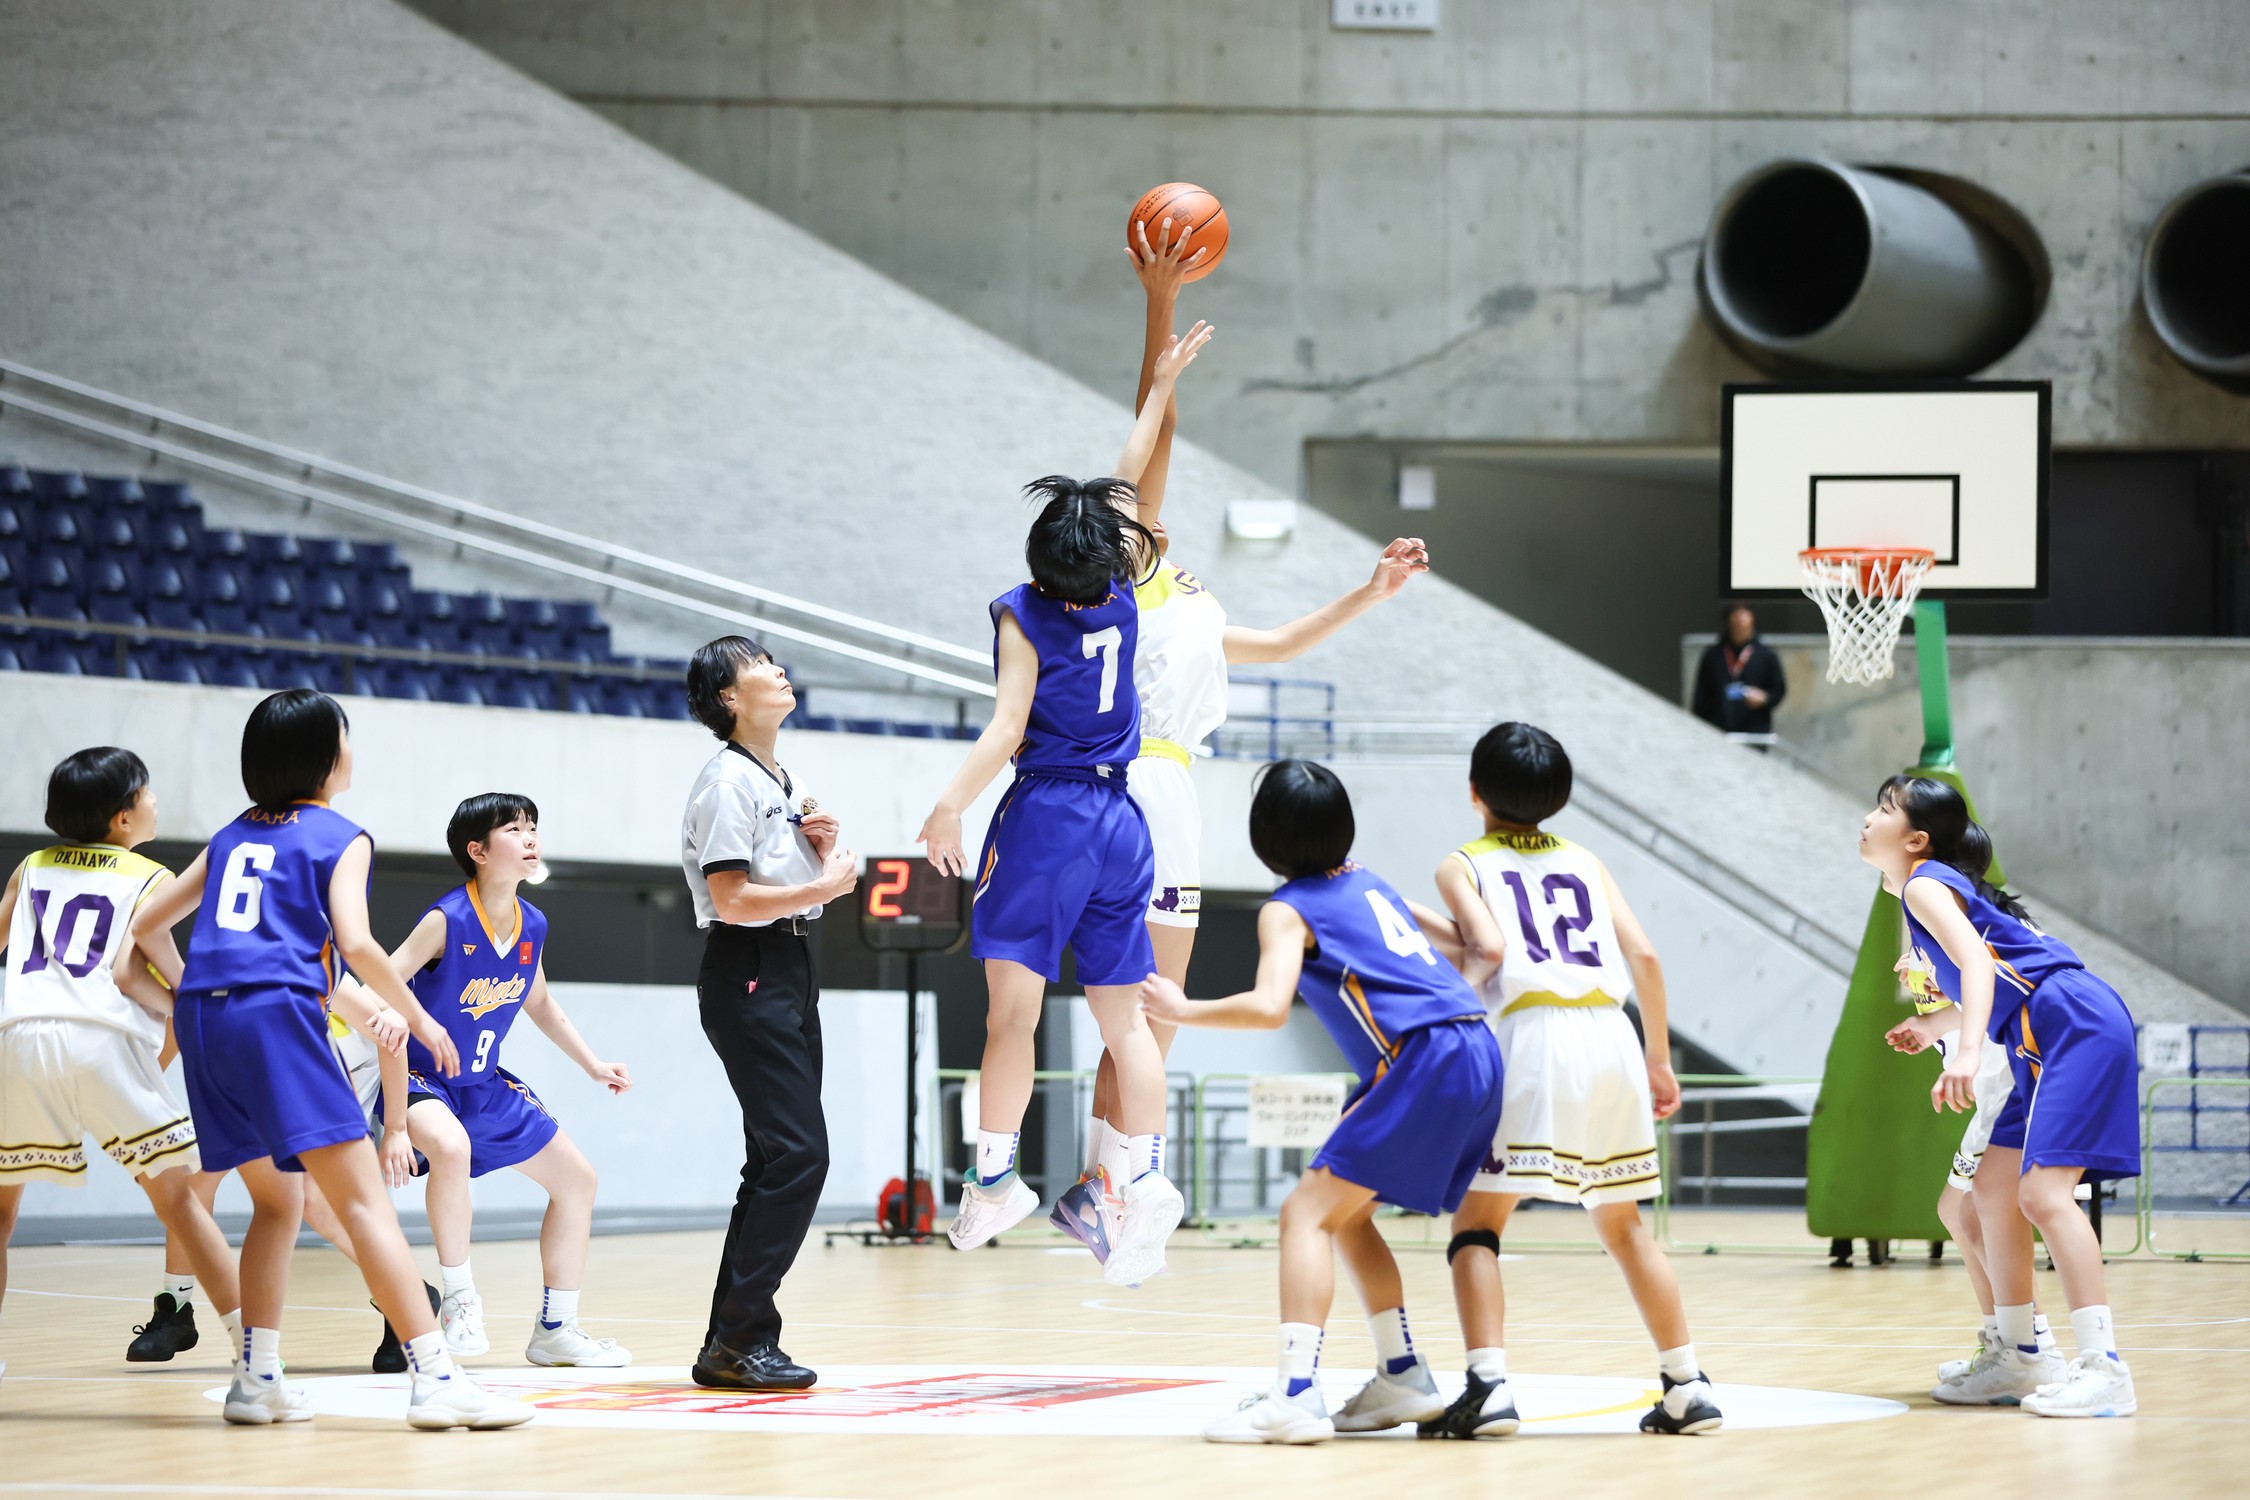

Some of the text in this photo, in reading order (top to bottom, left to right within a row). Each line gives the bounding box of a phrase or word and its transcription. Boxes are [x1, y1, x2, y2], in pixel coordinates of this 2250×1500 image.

[1082, 625, 1122, 714] 7
[54, 850, 118, 868] OKINAWA
[215, 841, 277, 933] 6
[869, 861, 910, 916] 2
[21, 888, 115, 978] 10
[1364, 889, 1438, 966] 4
[1500, 870, 1603, 967] 12
[471, 1029, 496, 1073] 9
